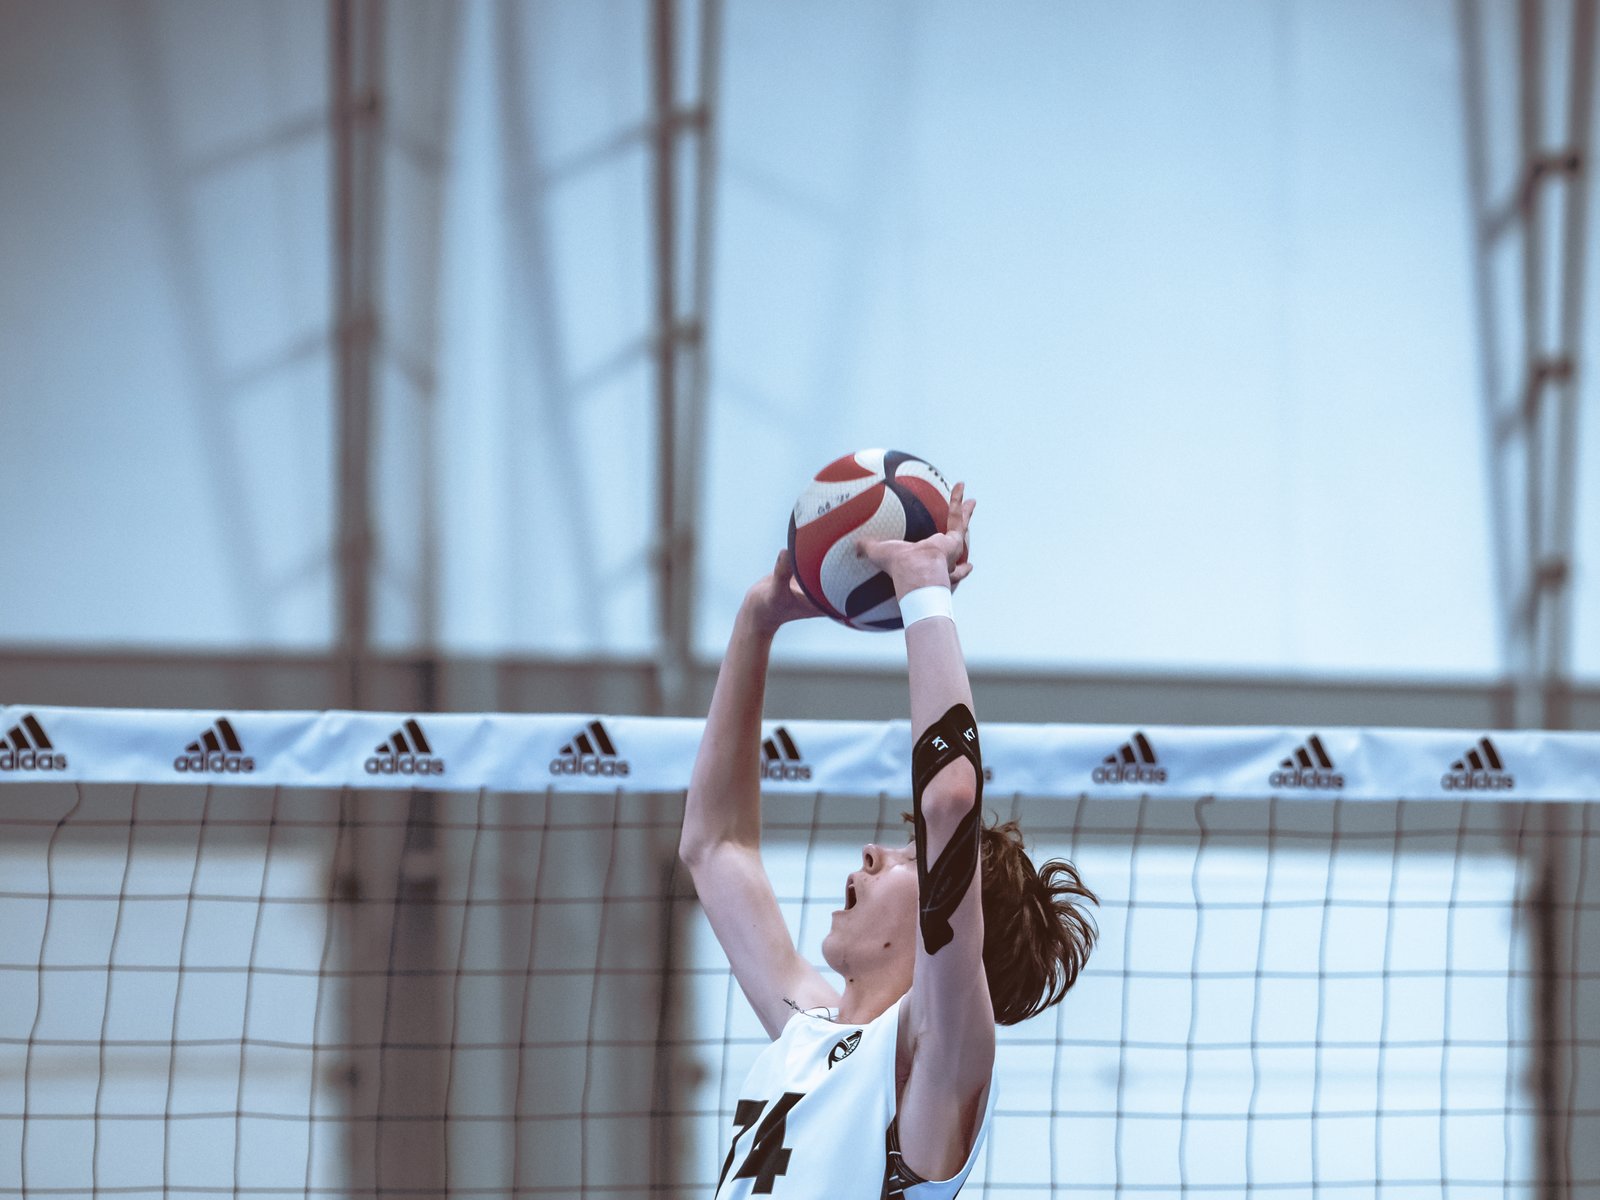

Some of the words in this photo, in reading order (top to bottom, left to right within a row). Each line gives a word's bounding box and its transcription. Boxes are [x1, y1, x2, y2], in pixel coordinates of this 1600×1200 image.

[931, 736, 949, 751] KT
[963, 727, 976, 742] KT
[0, 750, 67, 771] didas
[173, 751, 256, 773] adidas
[364, 753, 446, 776] adidas
[549, 754, 631, 778] adidas
[761, 761, 812, 781] idas
[1091, 764, 1168, 785] adidas
[1268, 769, 1346, 790] adidas
[1440, 769, 1515, 791] adidas
